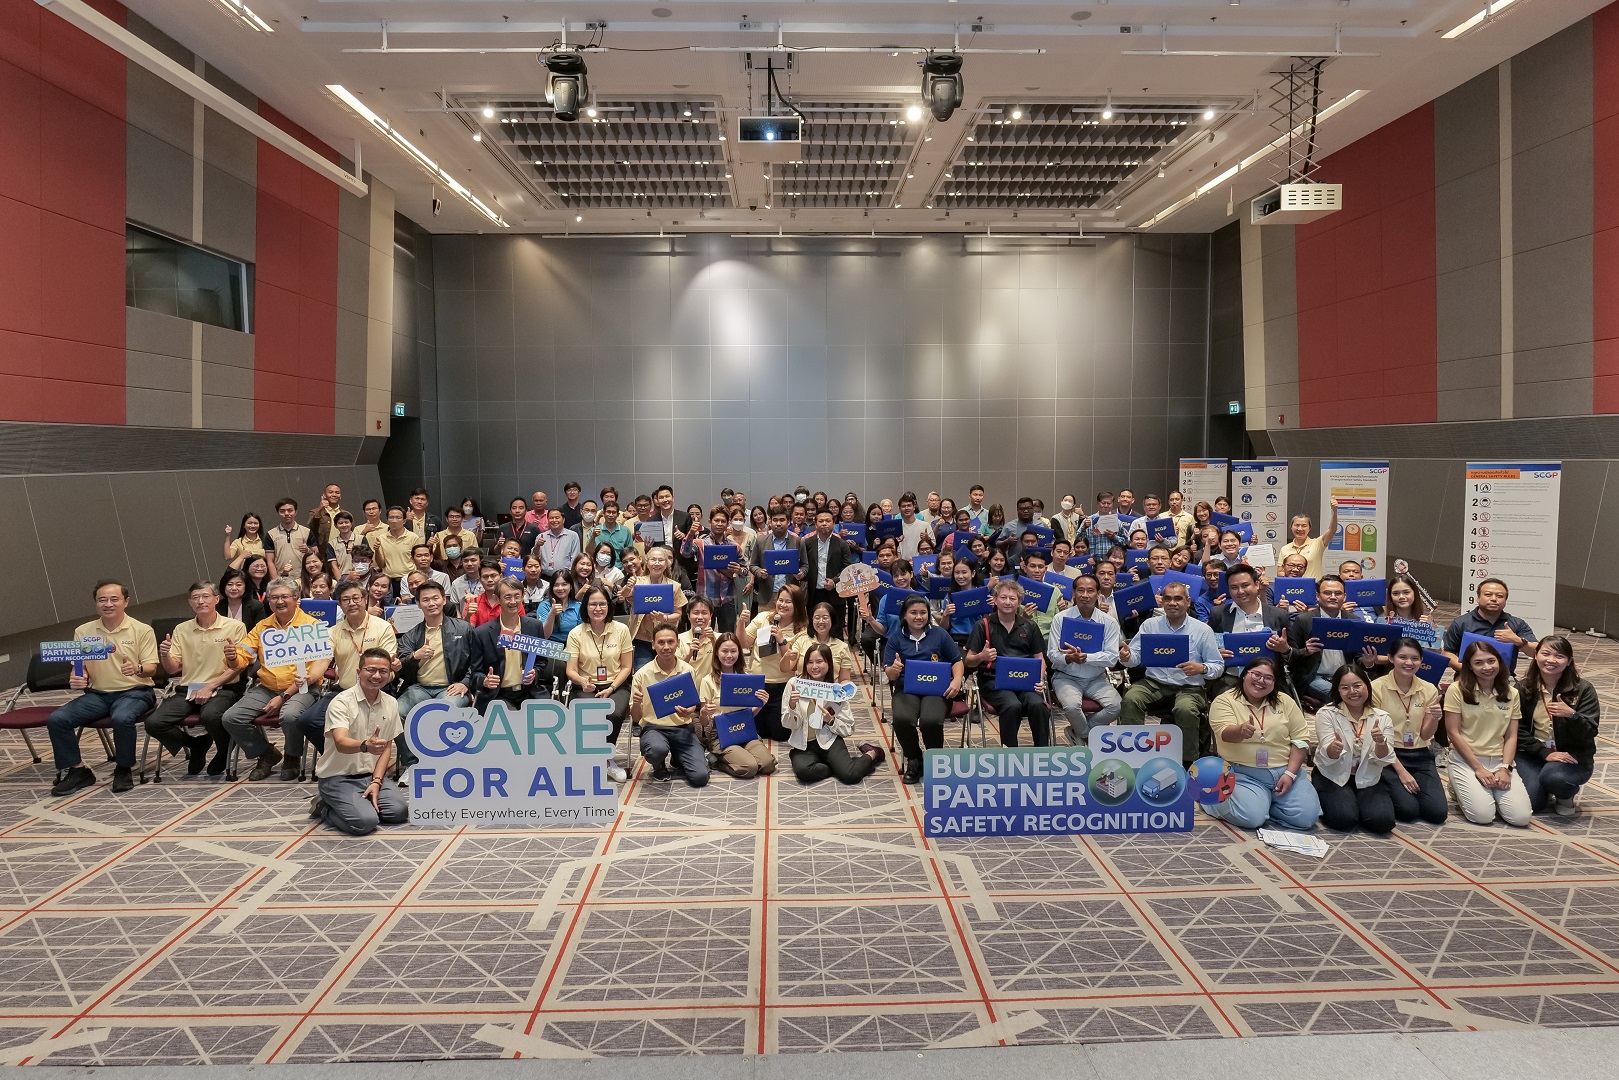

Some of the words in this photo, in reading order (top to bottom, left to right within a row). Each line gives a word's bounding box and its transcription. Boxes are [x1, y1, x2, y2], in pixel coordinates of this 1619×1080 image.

[1472, 498, 1478, 506] 2
[1472, 513, 1477, 521] 3
[842, 579, 875, 591] Contractor
[850, 586, 869, 594] Safety
[1024, 589, 1041, 598] SCGP
[1127, 596, 1144, 605] SCGP
[1468, 596, 1474, 604] 9
[263, 621, 329, 646] CARE
[1073, 632, 1092, 640] SCGP
[1326, 631, 1349, 639] SCGP
[1363, 635, 1386, 644] SCGP
[514, 635, 540, 646] DRIVE
[541, 640, 562, 650] SAFE
[265, 647, 297, 660] FOR
[304, 642, 331, 654] ALL
[512, 642, 547, 655] DELIVER
[548, 650, 570, 661] SAFE
[917, 674, 938, 682] SCGP
[796, 680, 834, 689] Transportation
[664, 690, 684, 702] SCGP
[795, 685, 839, 700] SAFETY
[410, 703, 612, 757] CARE
[728, 723, 745, 733] SCGP
[1101, 731, 1172, 753] SCGP
[932, 752, 1087, 779] BUSINESS
[414, 768, 508, 799] FOR
[528, 766, 614, 797] ALL
[932, 782, 1086, 808] PARTNER
[414, 809, 457, 821] Safety
[462, 808, 540, 820] Everywhere,
[545, 807, 580, 819] Every
[584, 806, 615, 817] Time
[930, 815, 1016, 834] SAFETY
[1024, 812, 1185, 831] RECOGNITION
